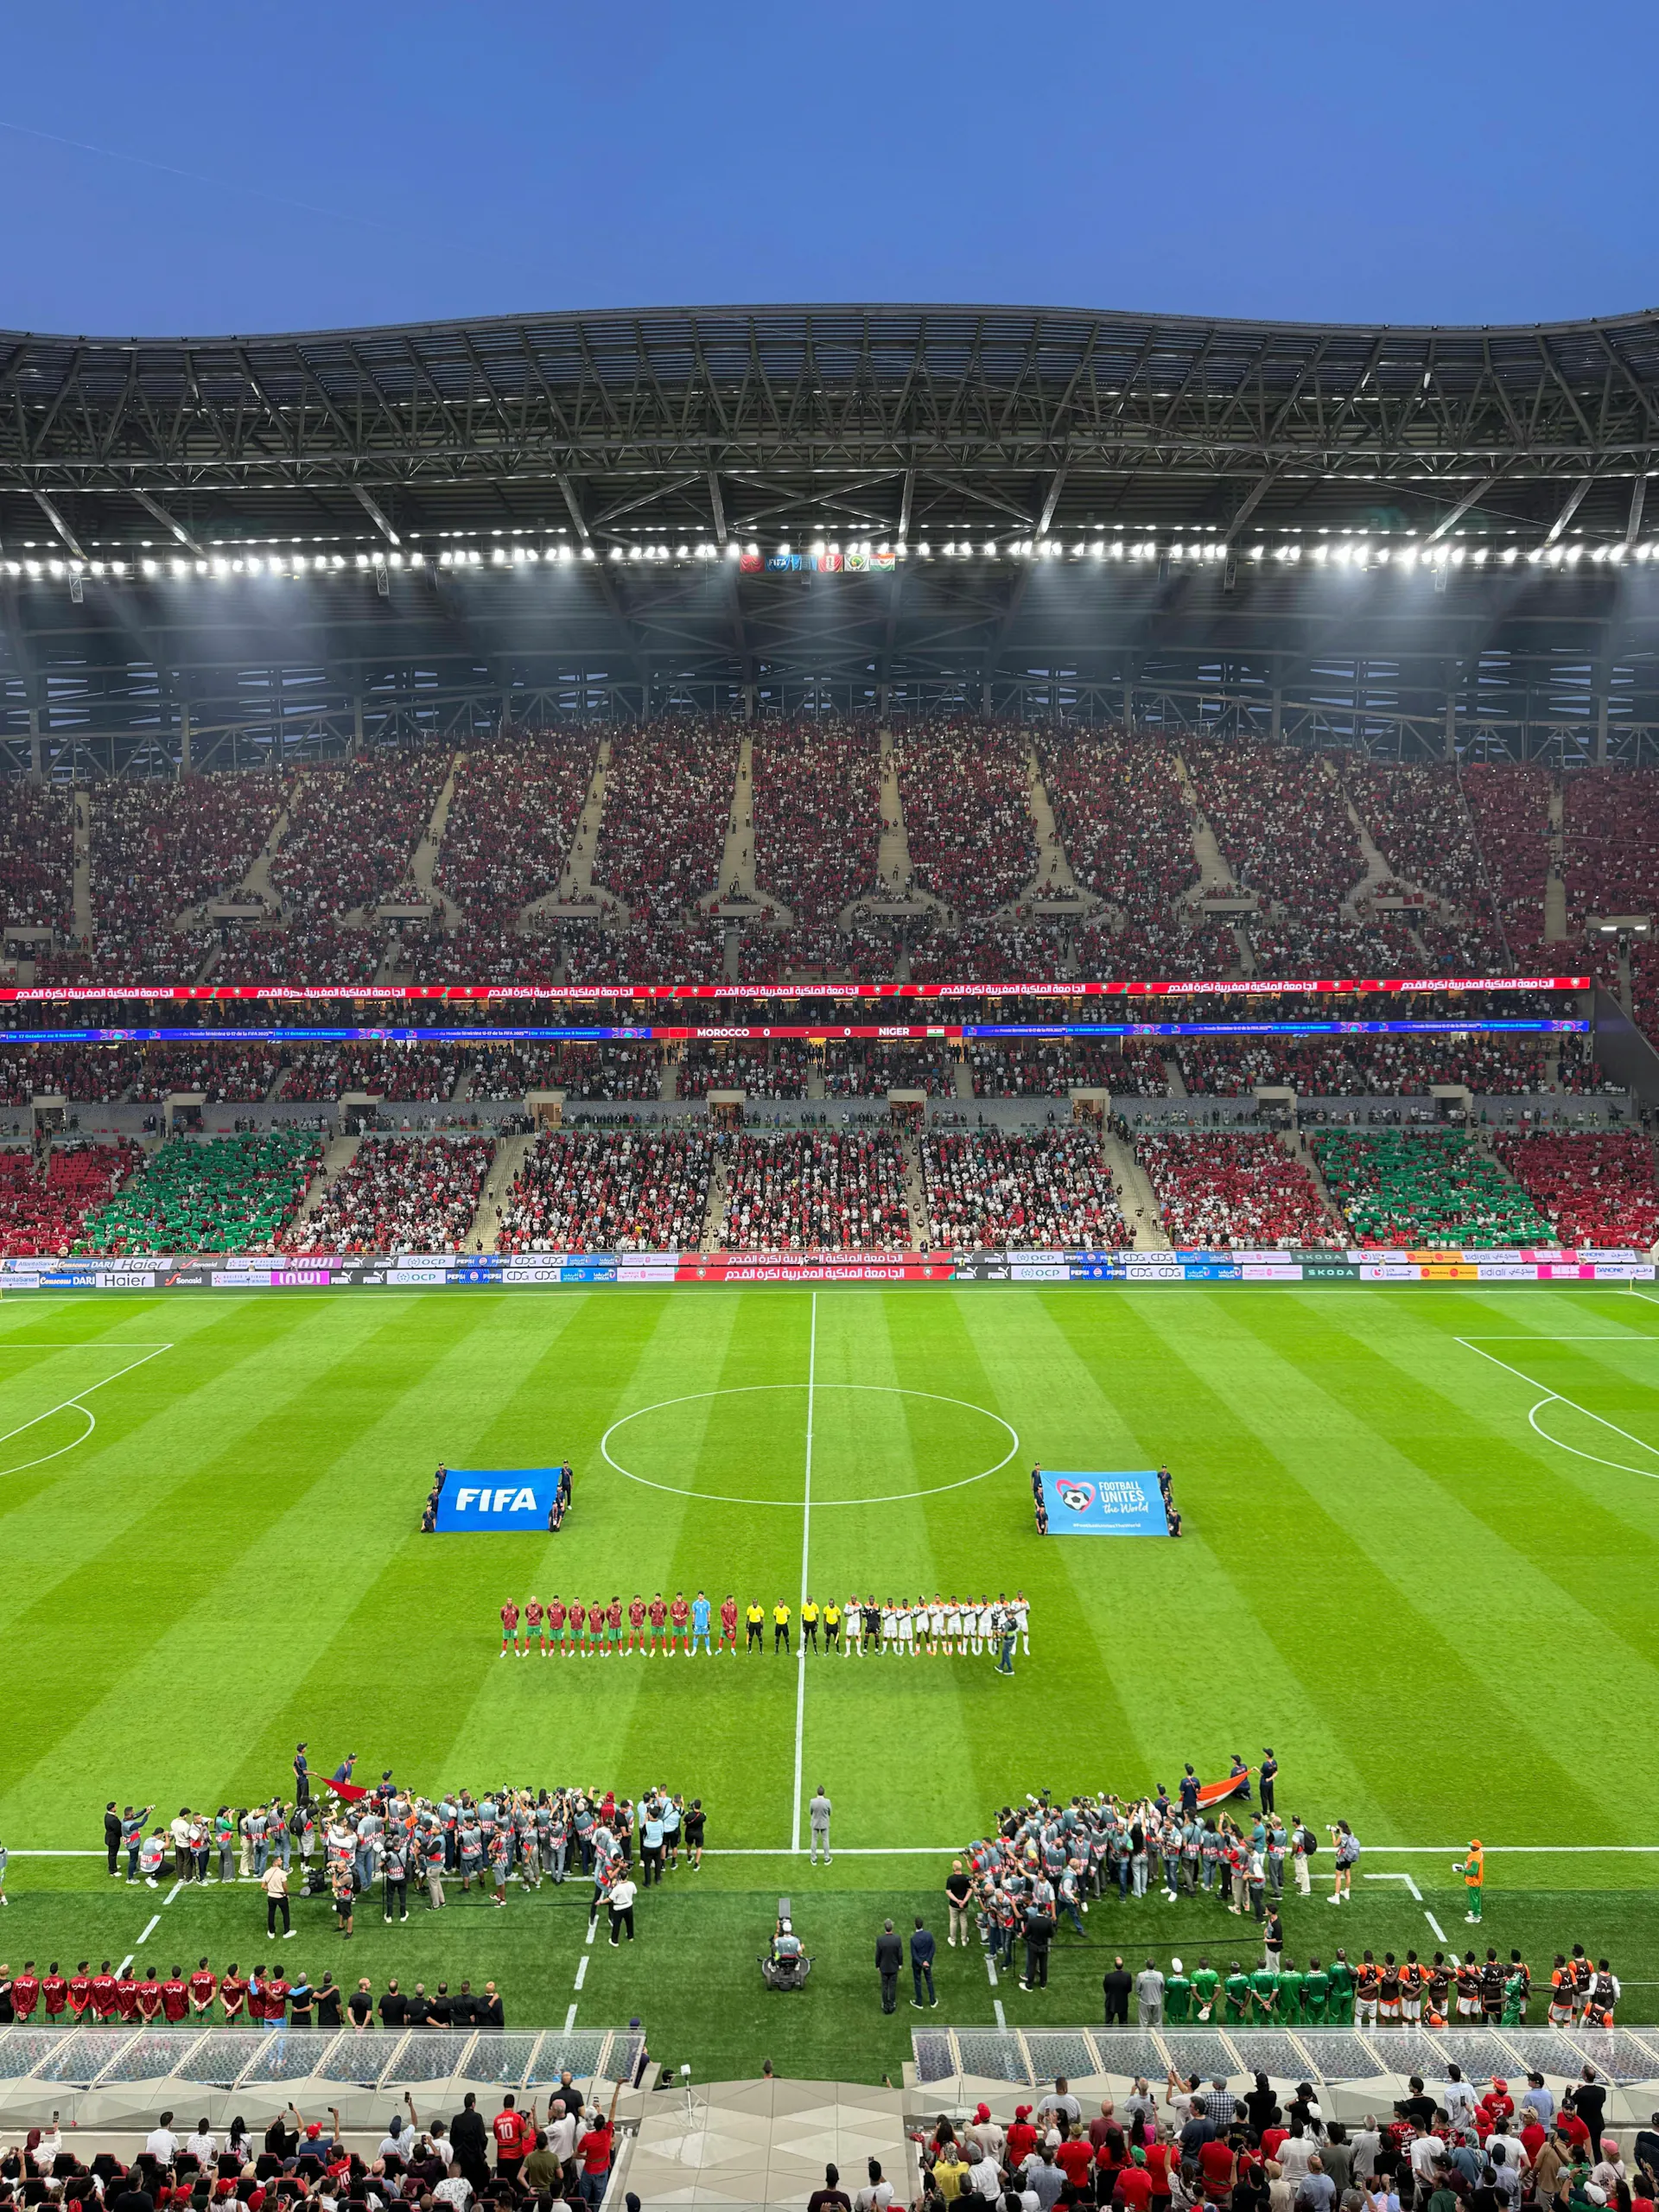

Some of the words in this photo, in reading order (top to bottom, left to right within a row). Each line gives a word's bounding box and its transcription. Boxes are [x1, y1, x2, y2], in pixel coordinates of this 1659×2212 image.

[121, 1259, 163, 1268] Haier
[292, 1258, 334, 1268] nwi
[728, 1255, 757, 1265] القدم
[759, 1255, 781, 1264] لكرة
[825, 1254, 862, 1263] الملكية
[864, 1254, 903, 1263] الجامعة
[1123, 1253, 1145, 1262] CDG
[1151, 1253, 1173, 1262] CDG
[279, 1272, 321, 1284] inwi
[506, 1271, 529, 1280] CDG
[534, 1270, 556, 1280] CDG
[725, 1268, 755, 1281] القدم
[757, 1268, 779, 1281] لكرة
[781, 1268, 823, 1280] المغربية
[825, 1268, 862, 1280] الملكية
[864, 1268, 905, 1280] الجامعة
[1130, 1268, 1153, 1277] CDG
[1159, 1268, 1181, 1277] CDG
[73, 1276, 95, 1285] DARI
[105, 1274, 145, 1286] Haier
[1098, 1481, 1141, 1491] FOOTBALL
[455, 1488, 537, 1511] FIFA
[1100, 1490, 1145, 1503] UNITES
[1103, 1503, 1119, 1514] the
[1120, 1502, 1149, 1513] World
[499, 2123, 513, 2139] 10
[340, 2171, 351, 2186] 10
